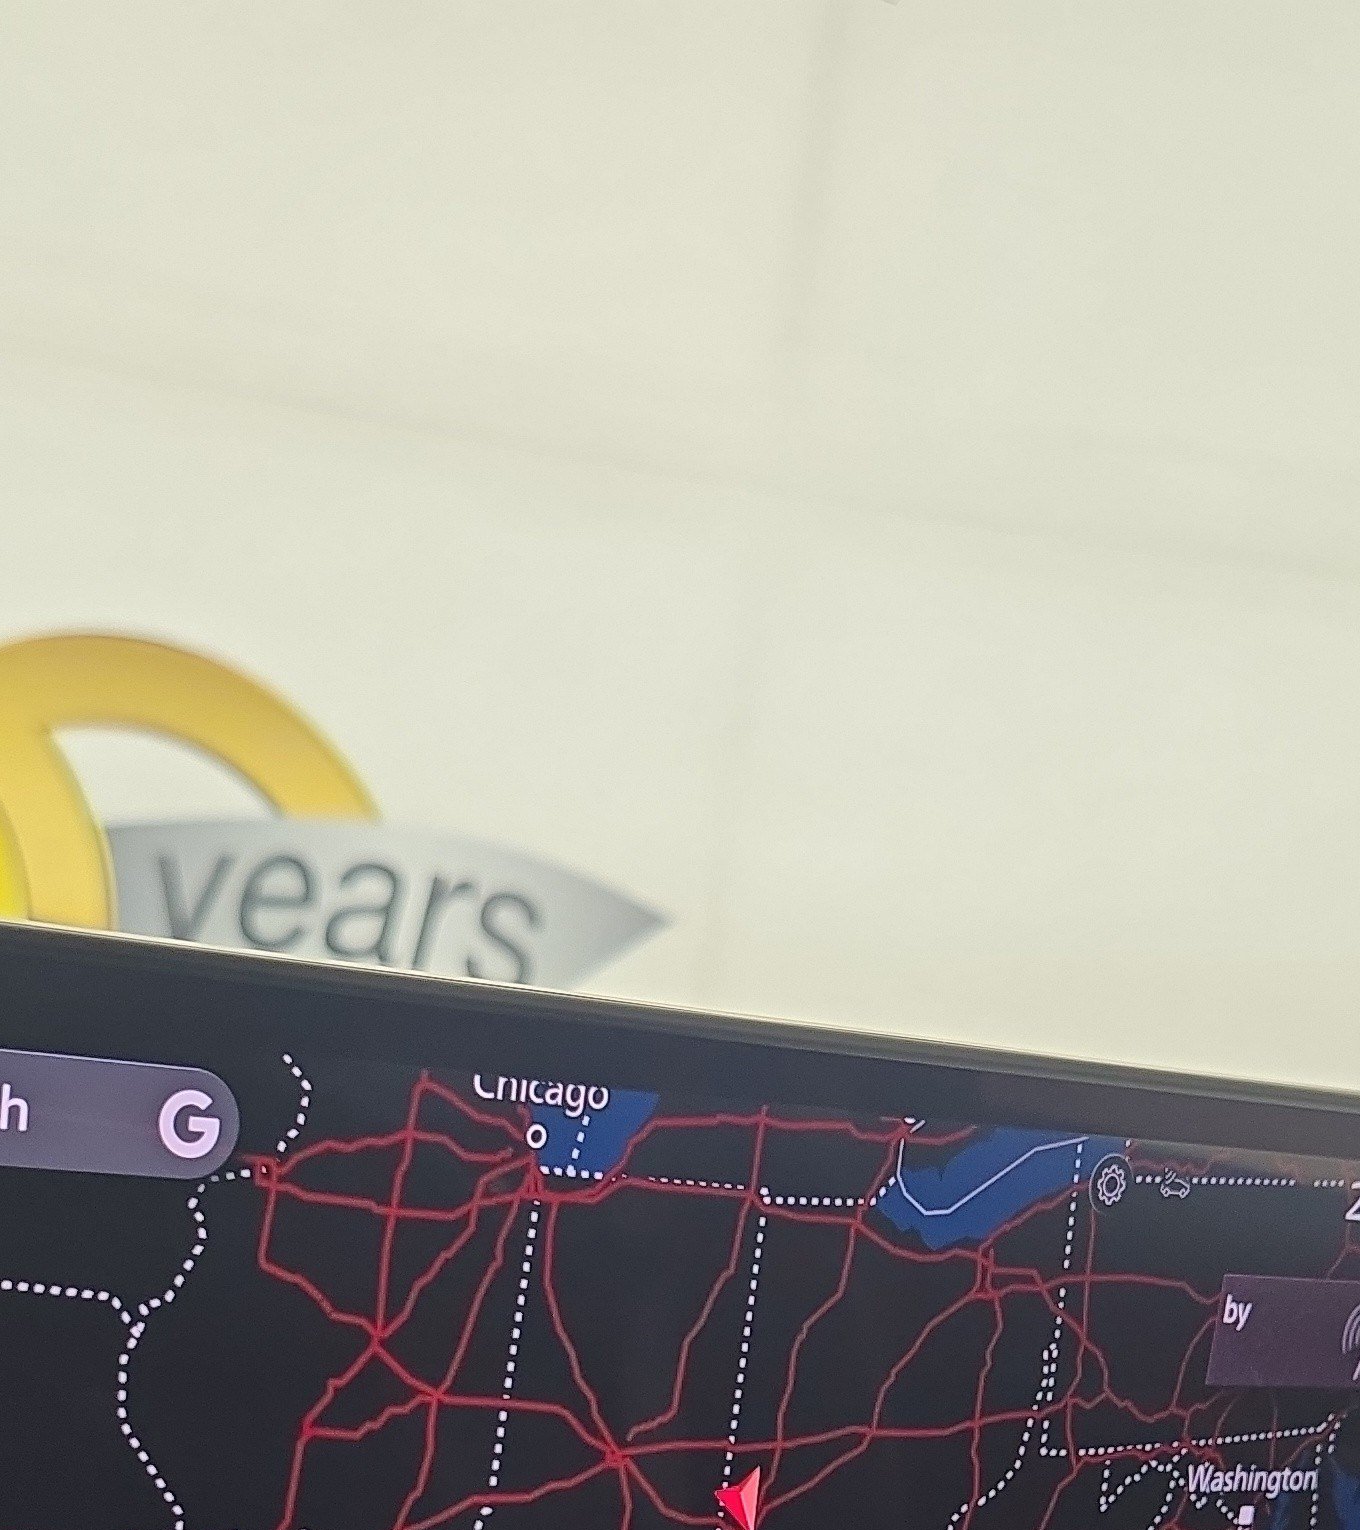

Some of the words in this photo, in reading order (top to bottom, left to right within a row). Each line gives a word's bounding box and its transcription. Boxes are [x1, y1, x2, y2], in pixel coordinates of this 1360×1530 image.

[156, 854, 542, 984] years
[158, 1089, 221, 1159] G
[1223, 1294, 1252, 1331] by
[1187, 1462, 1319, 1500] Washington
